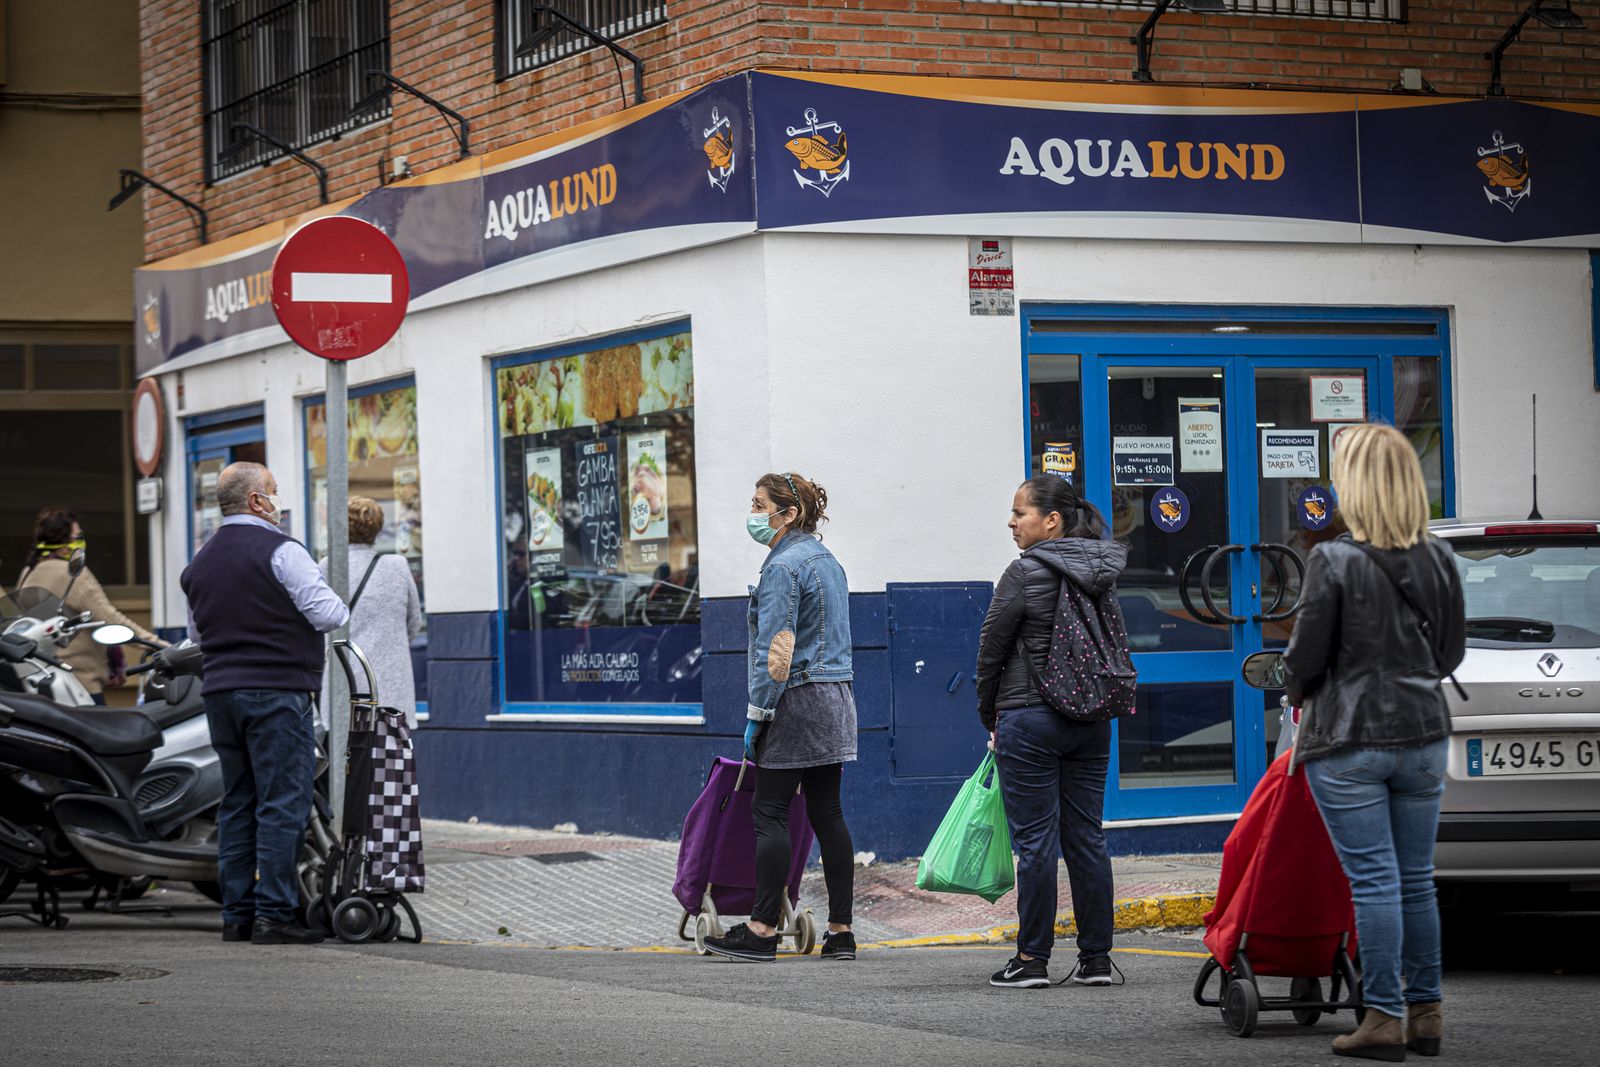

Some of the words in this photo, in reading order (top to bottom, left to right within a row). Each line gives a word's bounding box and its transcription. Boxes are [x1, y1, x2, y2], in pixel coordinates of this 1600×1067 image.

[999, 136, 1285, 185] AQUALUND
[484, 163, 617, 241] AQUALUND
[971, 270, 1013, 282] Alarma
[205, 270, 272, 323] AQUALU
[1268, 437, 1312, 445] RECOMENDAMOS
[1045, 454, 1073, 464] GRAN
[1267, 461, 1294, 469] TARJETA
[577, 453, 616, 487] GAMBA
[1115, 464, 1137, 474] 9:15h
[1144, 464, 1171, 474] 15:00h
[577, 485, 619, 519] BLANCA
[561, 654, 571, 669] LA
[572, 649, 588, 669] MÁS
[589, 653, 605, 668] ALTA
[606, 652, 639, 668] CALIDAD
[602, 669, 639, 682] CONGELADOS
[1518, 687, 1584, 698] CLIO
[1490, 741, 1565, 769] 4945
[1472, 761, 1479, 769] E
